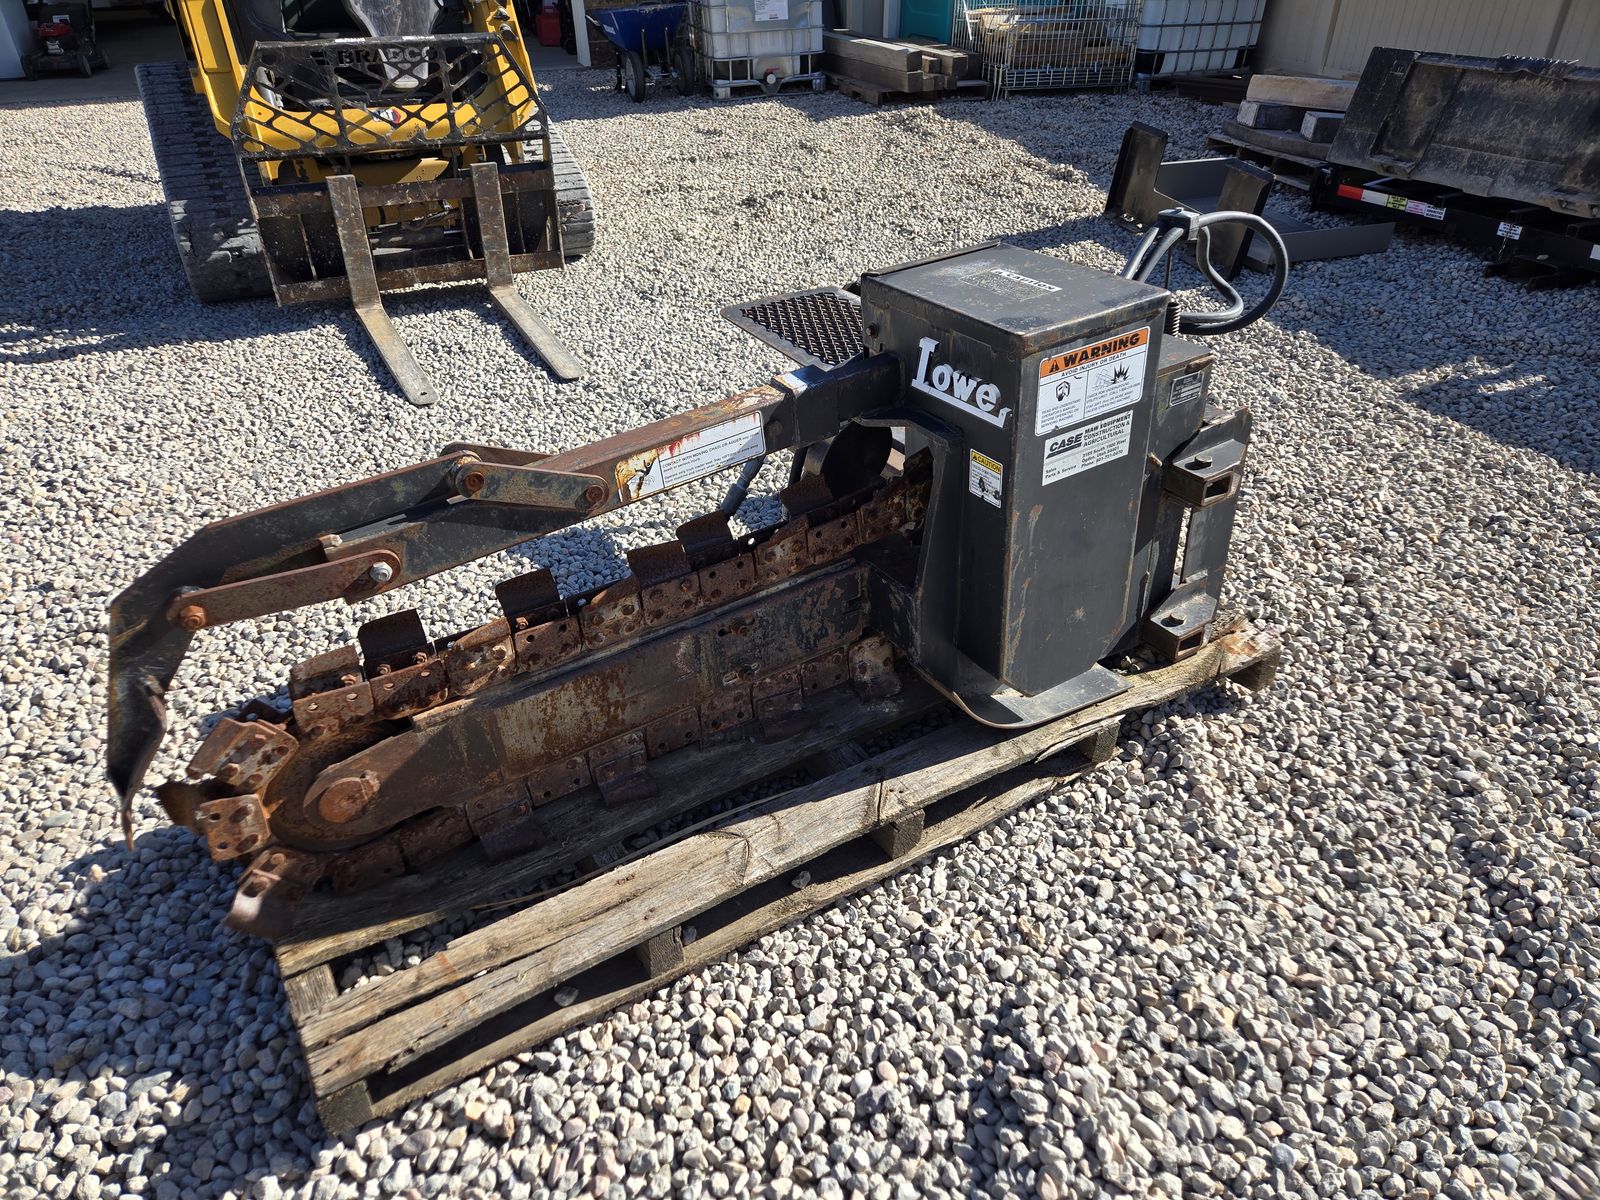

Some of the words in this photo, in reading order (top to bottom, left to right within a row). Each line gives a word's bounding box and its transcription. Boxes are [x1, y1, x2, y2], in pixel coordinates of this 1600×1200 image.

[337, 46, 440, 66] BRADCO
[1063, 333, 1140, 368] WARNING
[1060, 367, 1079, 378] AVOID
[1079, 361, 1098, 372] INJURY
[1108, 352, 1127, 363] DEATH
[911, 336, 1013, 429] Lowe
[1083, 423, 1125, 440] CONSTRUCTION
[1084, 425, 1099, 434] MAW
[1100, 414, 1131, 429] EQUIPMENT
[1049, 433, 1083, 452] CASE
[1083, 429, 1125, 447] AGRICULTURAL
[977, 456, 1001, 472] CAUTION
